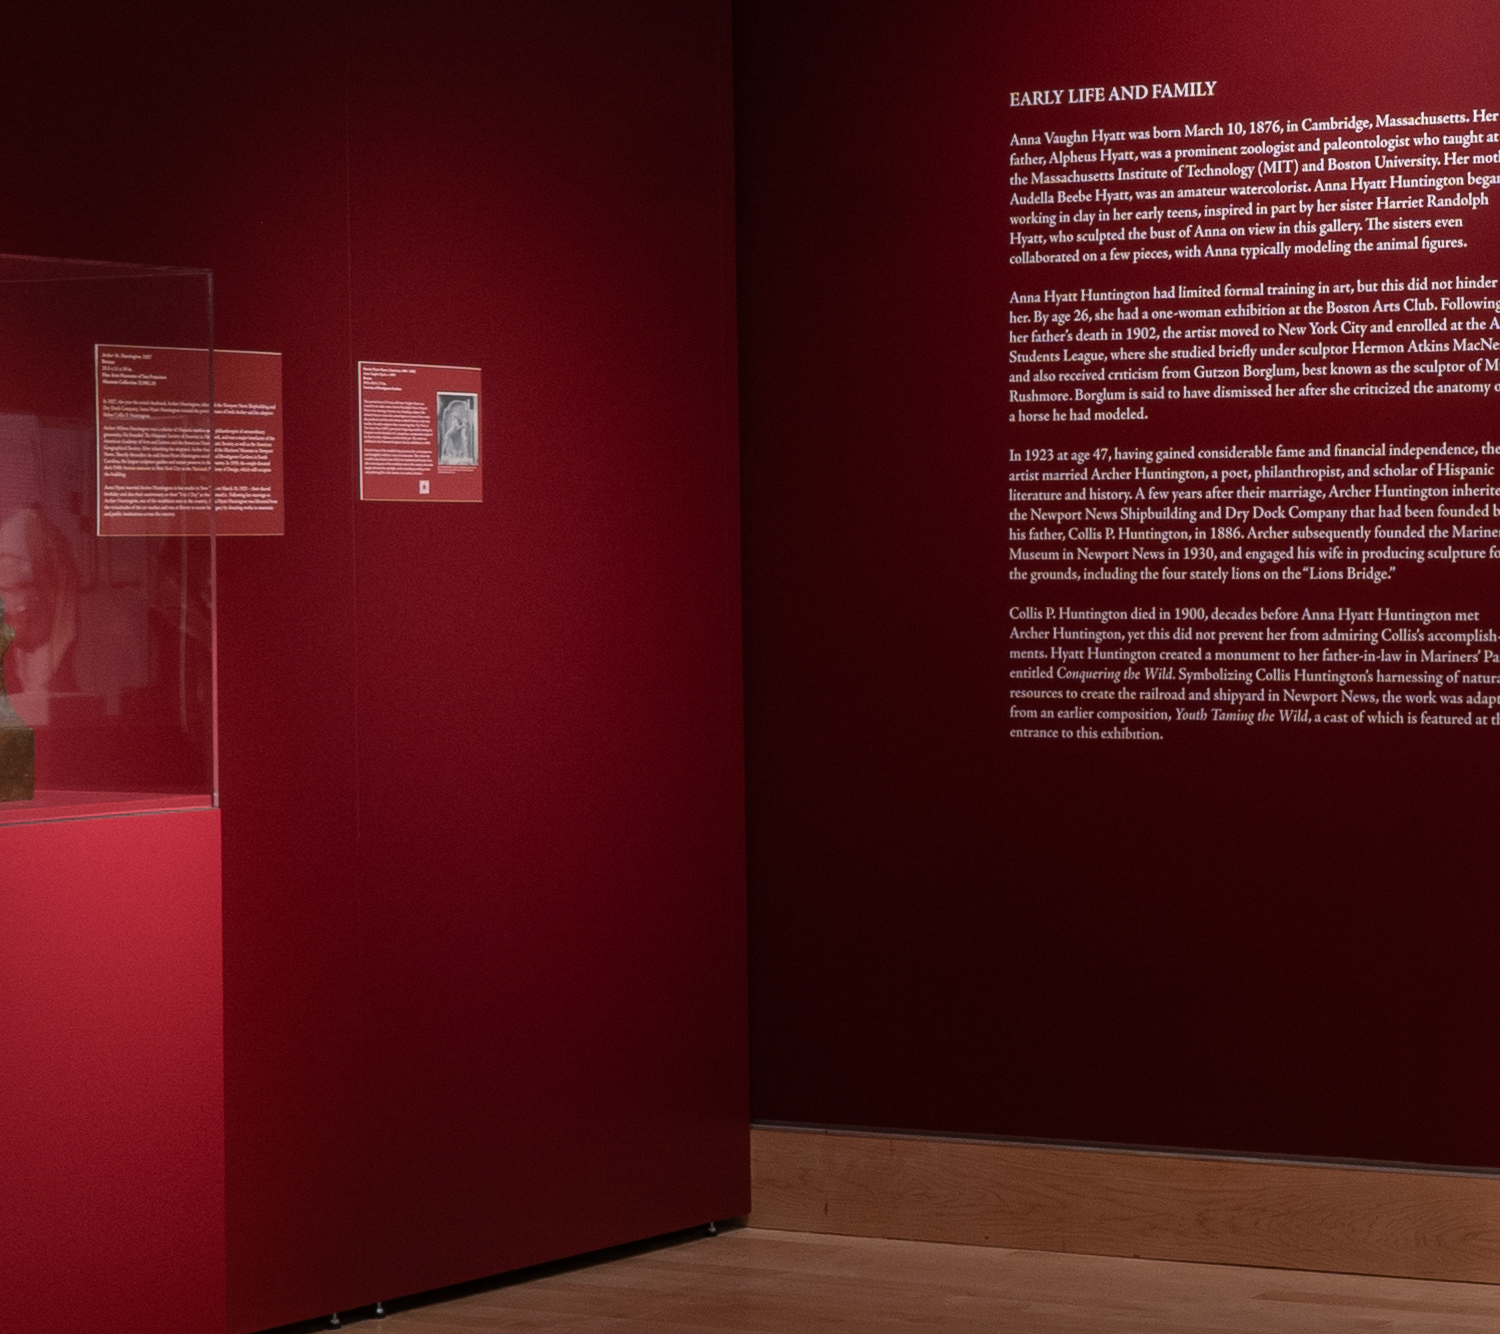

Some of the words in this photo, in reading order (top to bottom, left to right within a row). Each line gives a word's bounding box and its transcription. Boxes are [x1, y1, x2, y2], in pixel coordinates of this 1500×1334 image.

[1010, 90, 1064, 106] EARLY
[1069, 87, 1106, 103] LIFE
[1109, 85, 1149, 101] AND
[1152, 81, 1217, 98] FAMILY
[1011, 133, 1041, 145] Anna
[1045, 130, 1089, 148] Vaughn
[1092, 128, 1126, 145] Hyatt
[1129, 131, 1151, 140] was
[1153, 125, 1182, 138] born
[1185, 122, 1224, 137] March
[1228, 122, 1247, 136] 10,
[1250, 119, 1284, 135] 1876,
[1287, 121, 1299, 131] in
[1302, 115, 1373, 135] Cambridge,
[1376, 110, 1470, 127] Massachusetts.
[1473, 108, 1499, 122] Her
[1010, 151, 1047, 167] father,
[1049, 149, 1097, 167] Alpheus
[1101, 147, 1139, 165] Hyatt,
[1141, 150, 1163, 159] was
[1165, 149, 1172, 158] a
[1175, 144, 1238, 161] prominent
[1241, 140, 1296, 158] zoologist
[1298, 138, 1321, 151] and
[1324, 134, 1411, 154] paleontologist
[1414, 132, 1440, 145] who
[1443, 130, 1484, 148] taught
[1487, 132, 1500, 142] at
[1010, 172, 1028, 185] the
[1032, 168, 1115, 184] Massachusetts
[1118, 166, 1168, 180] Institute
[1171, 165, 1185, 178] of
[1186, 161, 1255, 181] Technology
[1258, 159, 1299, 177] (MIT)
[1302, 158, 1325, 171] and
[1328, 156, 1372, 170] Boston
[1375, 153, 1441, 171] University.
[1444, 152, 1470, 165] Her
[1010, 291, 1041, 303] Anna
[1045, 289, 1078, 306] Hyatt
[1081, 287, 1150, 305] Huntington
[1153, 286, 1176, 298] had
[1179, 284, 1221, 297] limited
[1225, 283, 1264, 296] formal
[1267, 284, 1316, 299] training
[1318, 283, 1330, 293] in
[1333, 282, 1355, 294] art,
[1357, 279, 1379, 292] but
[1381, 278, 1405, 291] this
[1407, 277, 1428, 290] did
[1432, 279, 1453, 289] not
[1456, 275, 1498, 288] hinder
[1009, 413, 1016, 422] a
[1019, 409, 1051, 421] horse
[1053, 408, 1067, 421] he
[1070, 408, 1092, 420] had
[1094, 406, 1149, 420] modeled.
[1010, 471, 1040, 481] artist
[1042, 468, 1088, 481] married
[1092, 467, 1132, 480] Archer
[1135, 466, 1209, 483] Huntington,
[1212, 470, 1218, 478] a
[1222, 468, 1252, 482] poet,
[1255, 464, 1345, 482] philanthropist,
[1348, 464, 1370, 476] and
[1374, 463, 1418, 476] scholar
[1421, 463, 1436, 475] of
[1437, 463, 1495, 479] Hispanic
[1010, 649, 1048, 659] ments.
[1051, 647, 1085, 663] Hyatt
[1088, 647, 1157, 664] Huntington
[1160, 647, 1202, 660] created
[1205, 652, 1212, 660] a
[1215, 650, 1280, 661] monument
[1284, 650, 1296, 661] to
[1299, 648, 1319, 661] her
[1323, 648, 1402, 662] father-in-law
[1405, 651, 1418, 662] in
[1421, 649, 1481, 663] Mariners’
[1010, 727, 1059, 739] entrance
[1062, 728, 1074, 739] to
[1077, 726, 1099, 739] this
[1101, 726, 1164, 740] exhibition.
